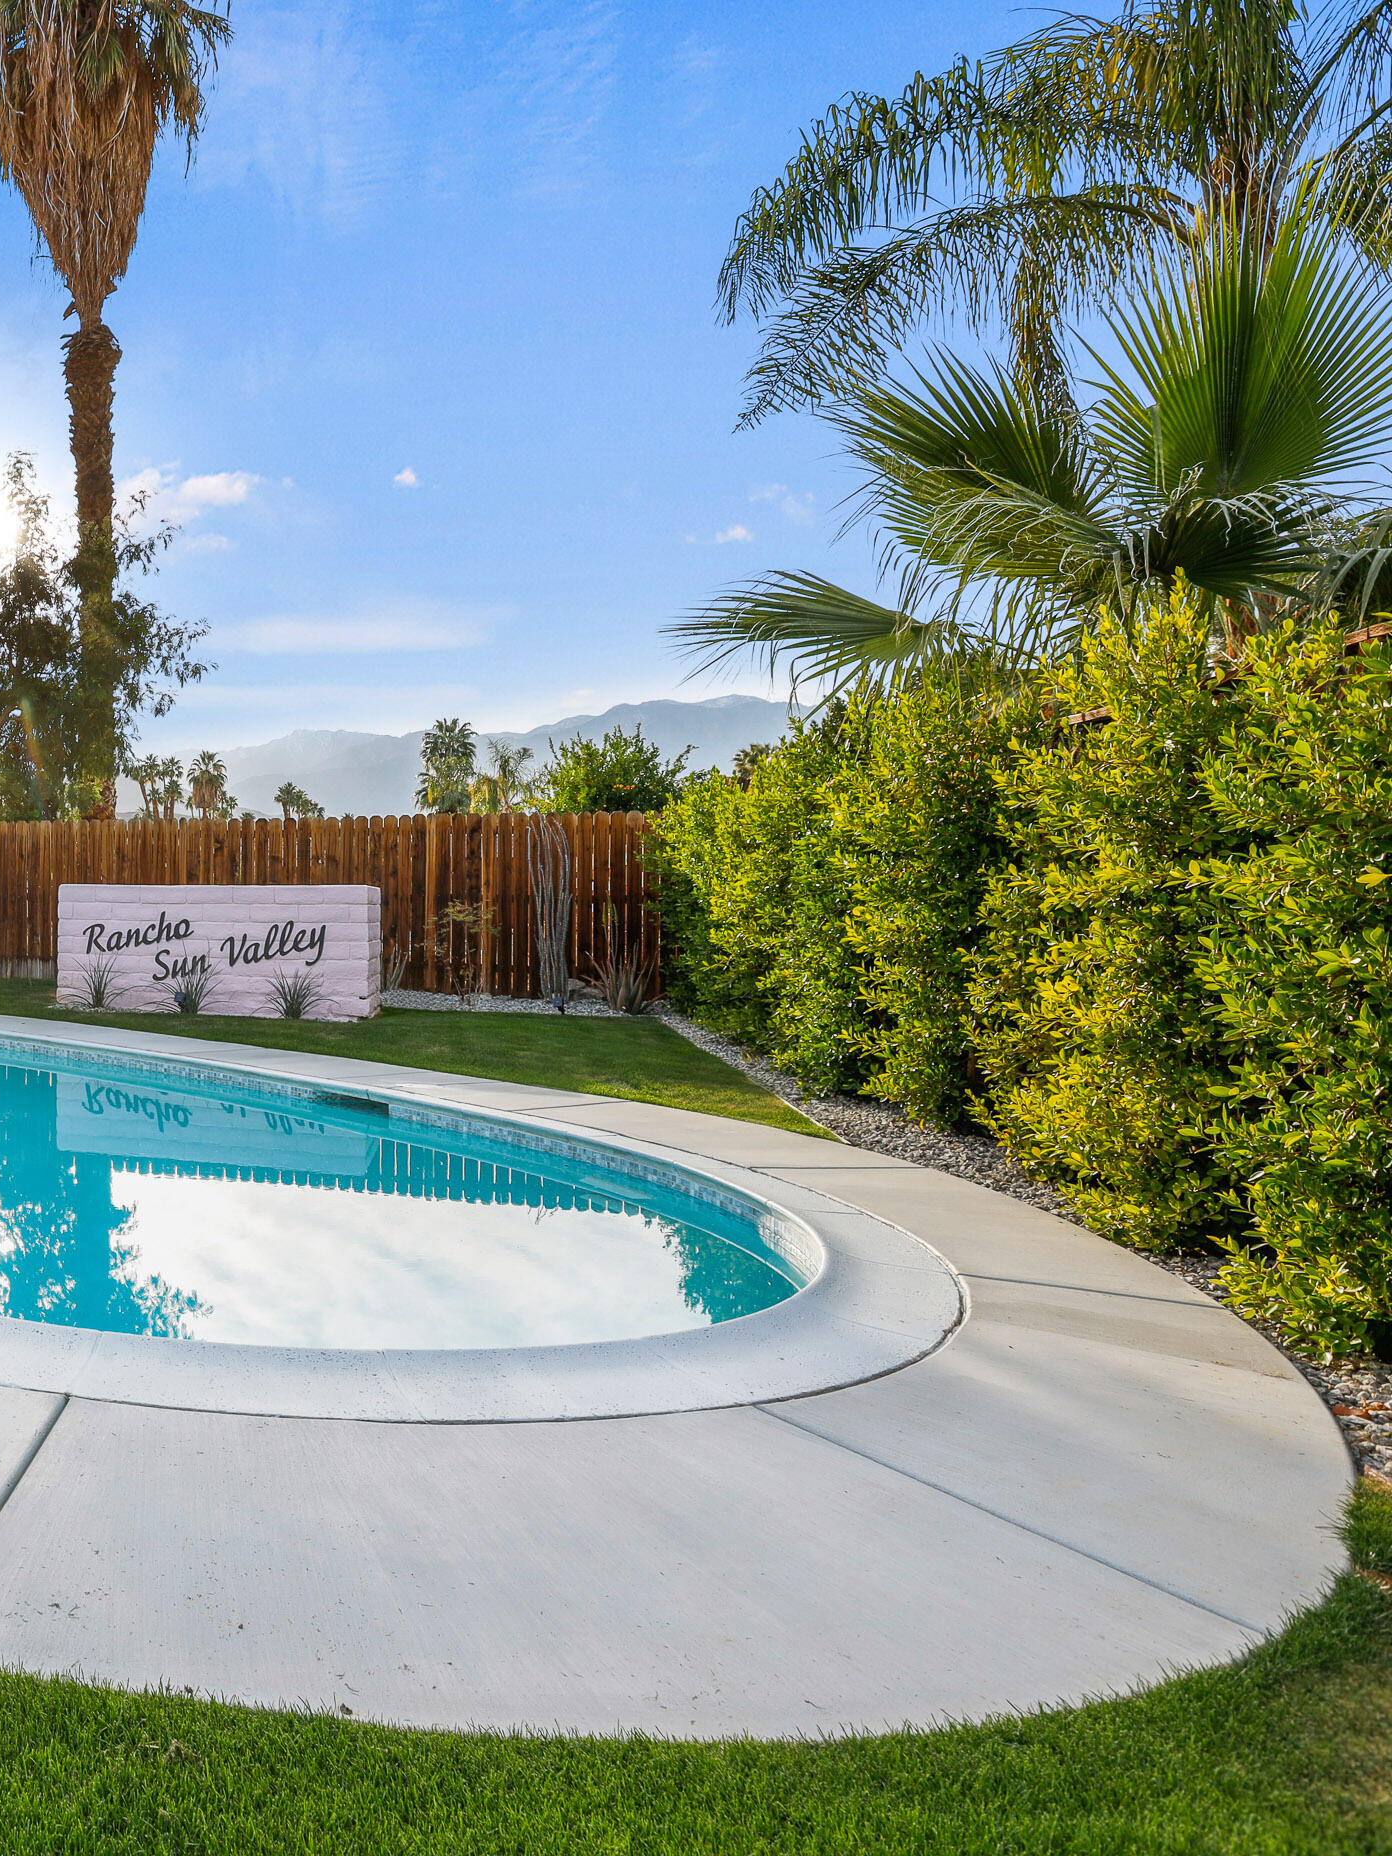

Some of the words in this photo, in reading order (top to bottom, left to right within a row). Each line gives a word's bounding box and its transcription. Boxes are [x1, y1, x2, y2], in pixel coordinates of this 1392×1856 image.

[83, 911, 194, 954] Rancho
[152, 949, 212, 981] Sun
[220, 920, 327, 967] Valley
